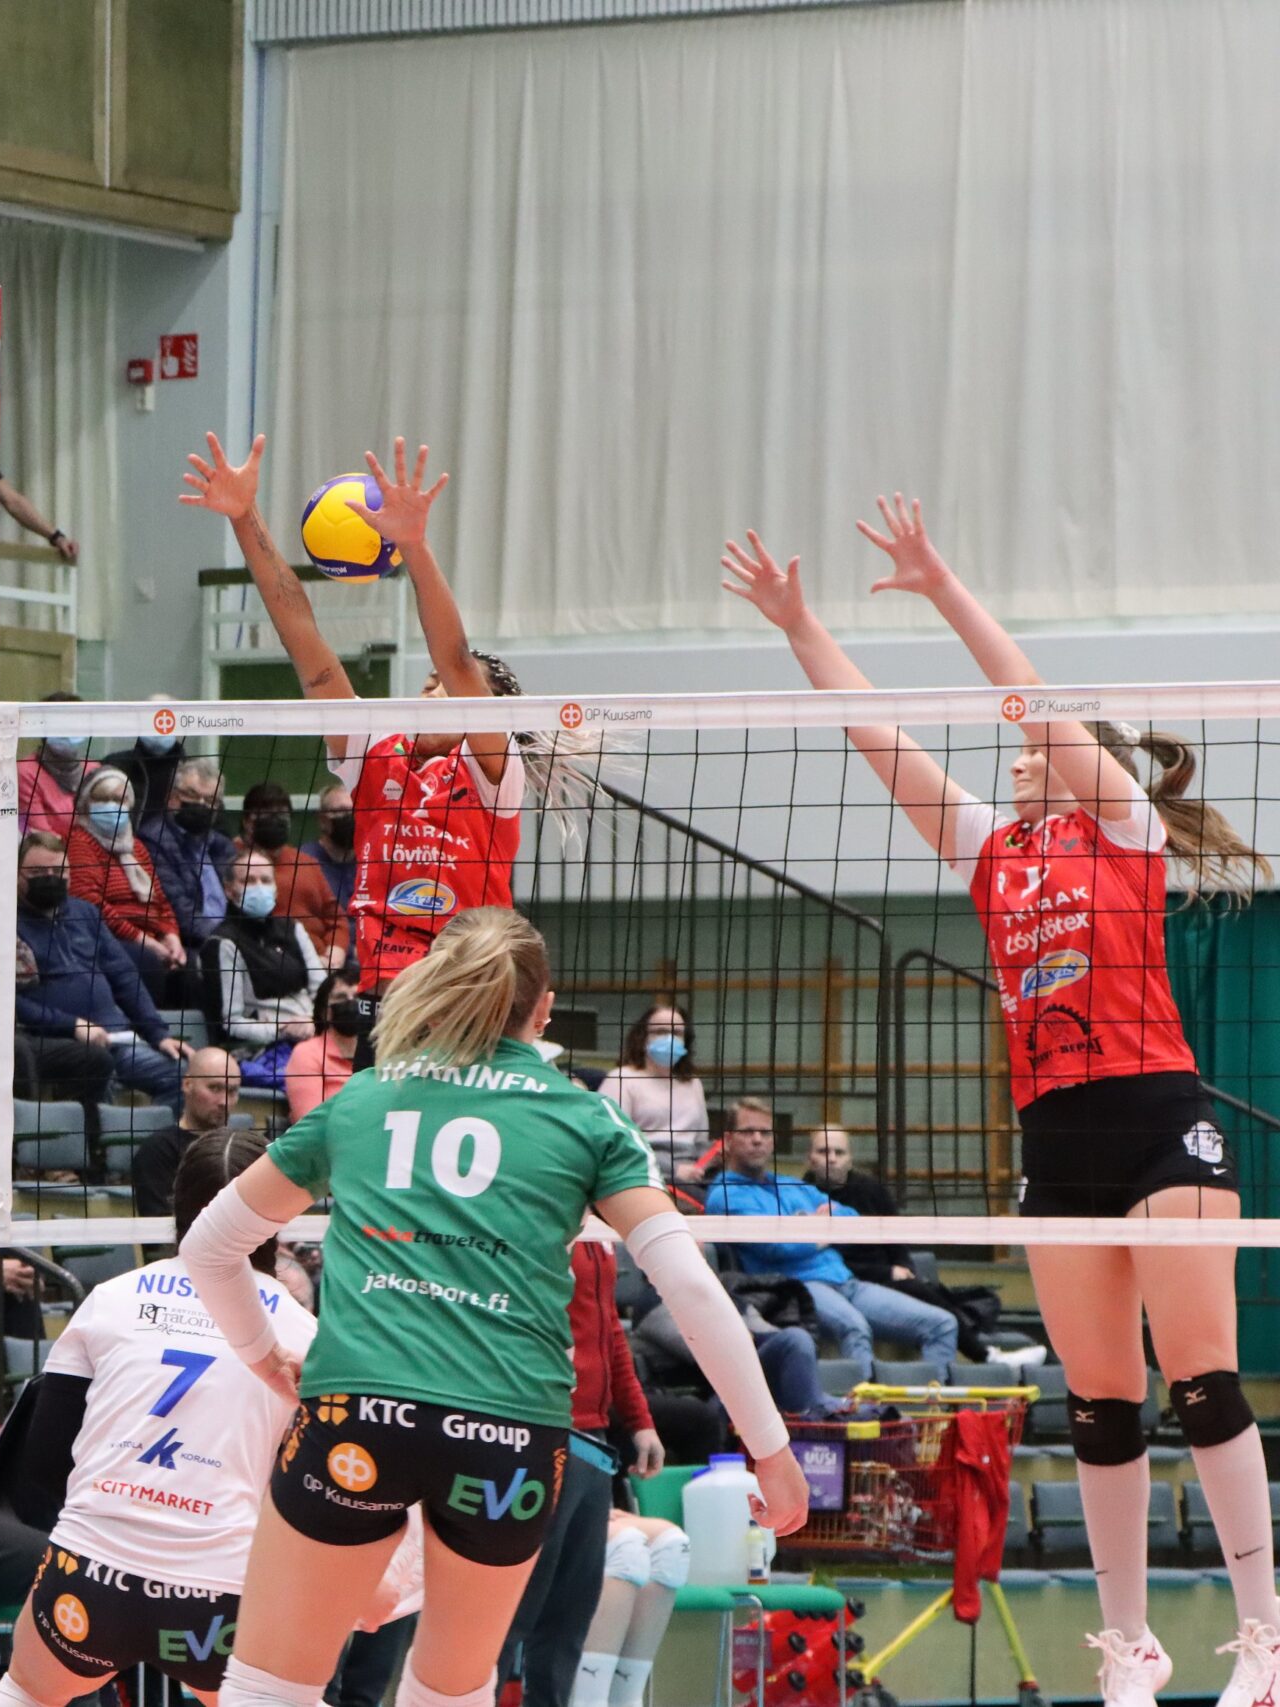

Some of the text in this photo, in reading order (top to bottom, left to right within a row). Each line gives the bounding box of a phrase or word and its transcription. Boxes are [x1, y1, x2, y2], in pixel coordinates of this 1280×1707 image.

[180, 714, 195, 728] OP
[197, 716, 244, 728] Kuusamo
[585, 707, 600, 721] OP
[603, 708, 653, 721] Kuusamo
[1029, 699, 1046, 714] OP
[1048, 700, 1101, 713] Kuusamo
[384, 1110, 502, 1198] 10
[361, 1270, 510, 1313] jakosport.fi
[148, 1348, 218, 1419] 7
[359, 1396, 531, 1453] KTC Group
[181, 1452, 223, 1469] KORAMO
[101, 1480, 214, 1516] CITYMARKET
[325, 1486, 405, 1511] Kuusamo
[447, 1467, 546, 1521] EVO
[143, 1578, 224, 1603] Group
